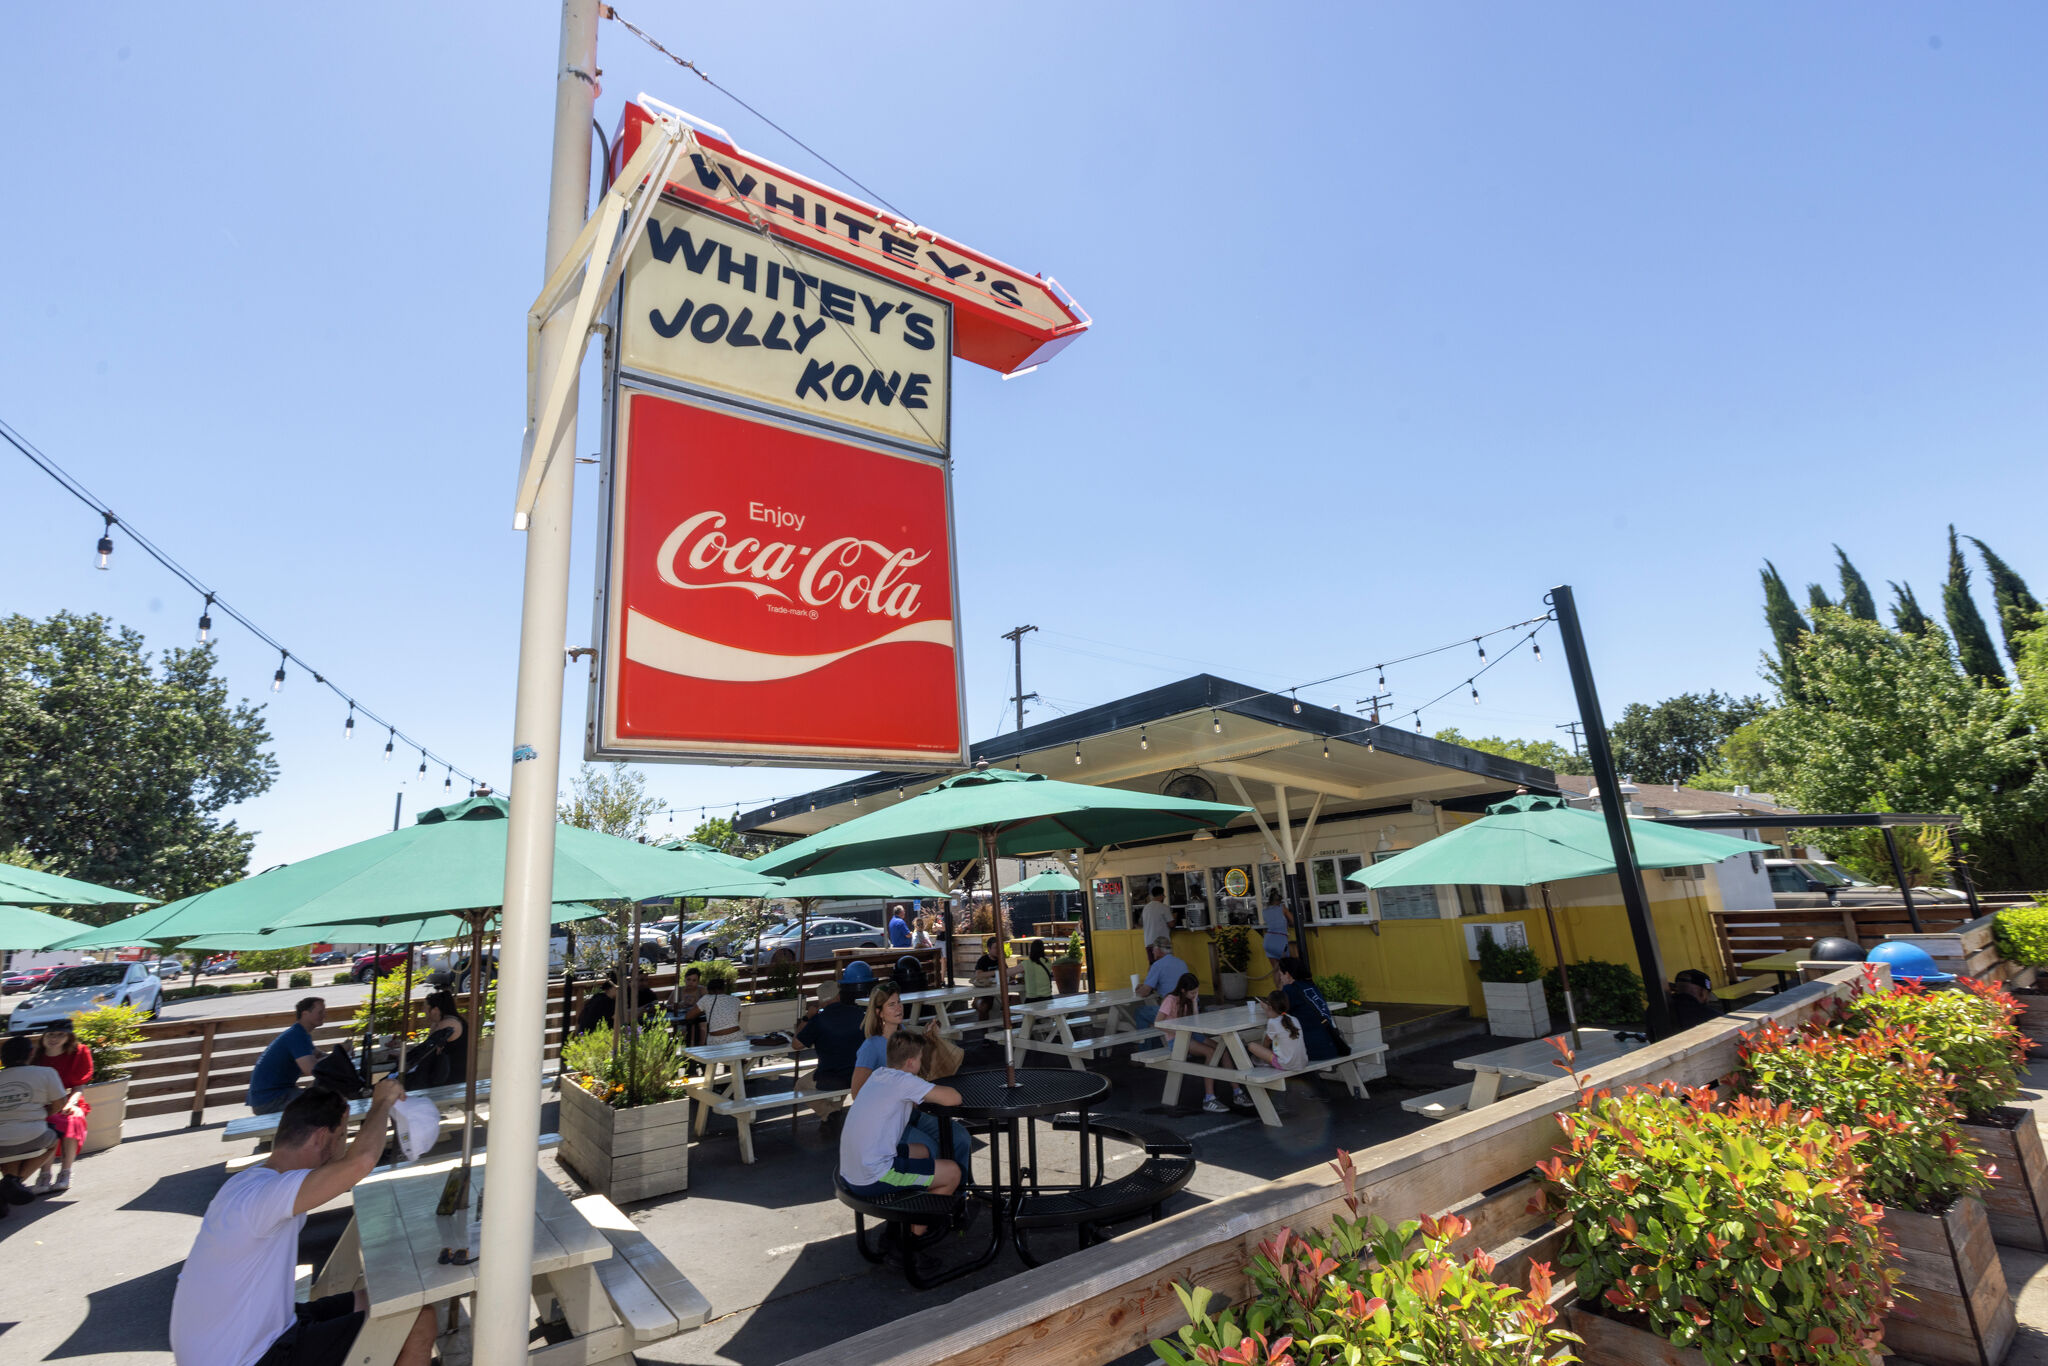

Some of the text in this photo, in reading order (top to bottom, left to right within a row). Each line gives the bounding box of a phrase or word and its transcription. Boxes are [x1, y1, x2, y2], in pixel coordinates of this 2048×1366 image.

[690, 153, 1024, 309] WHITEY'S
[647, 217, 936, 352] WHITEY'S
[649, 298, 827, 354] JOLLY
[795, 358, 931, 409] KONE
[749, 501, 806, 532] Enjoy
[656, 510, 931, 619] Coca-Cola
[1097, 882, 1121, 895] OPEN
